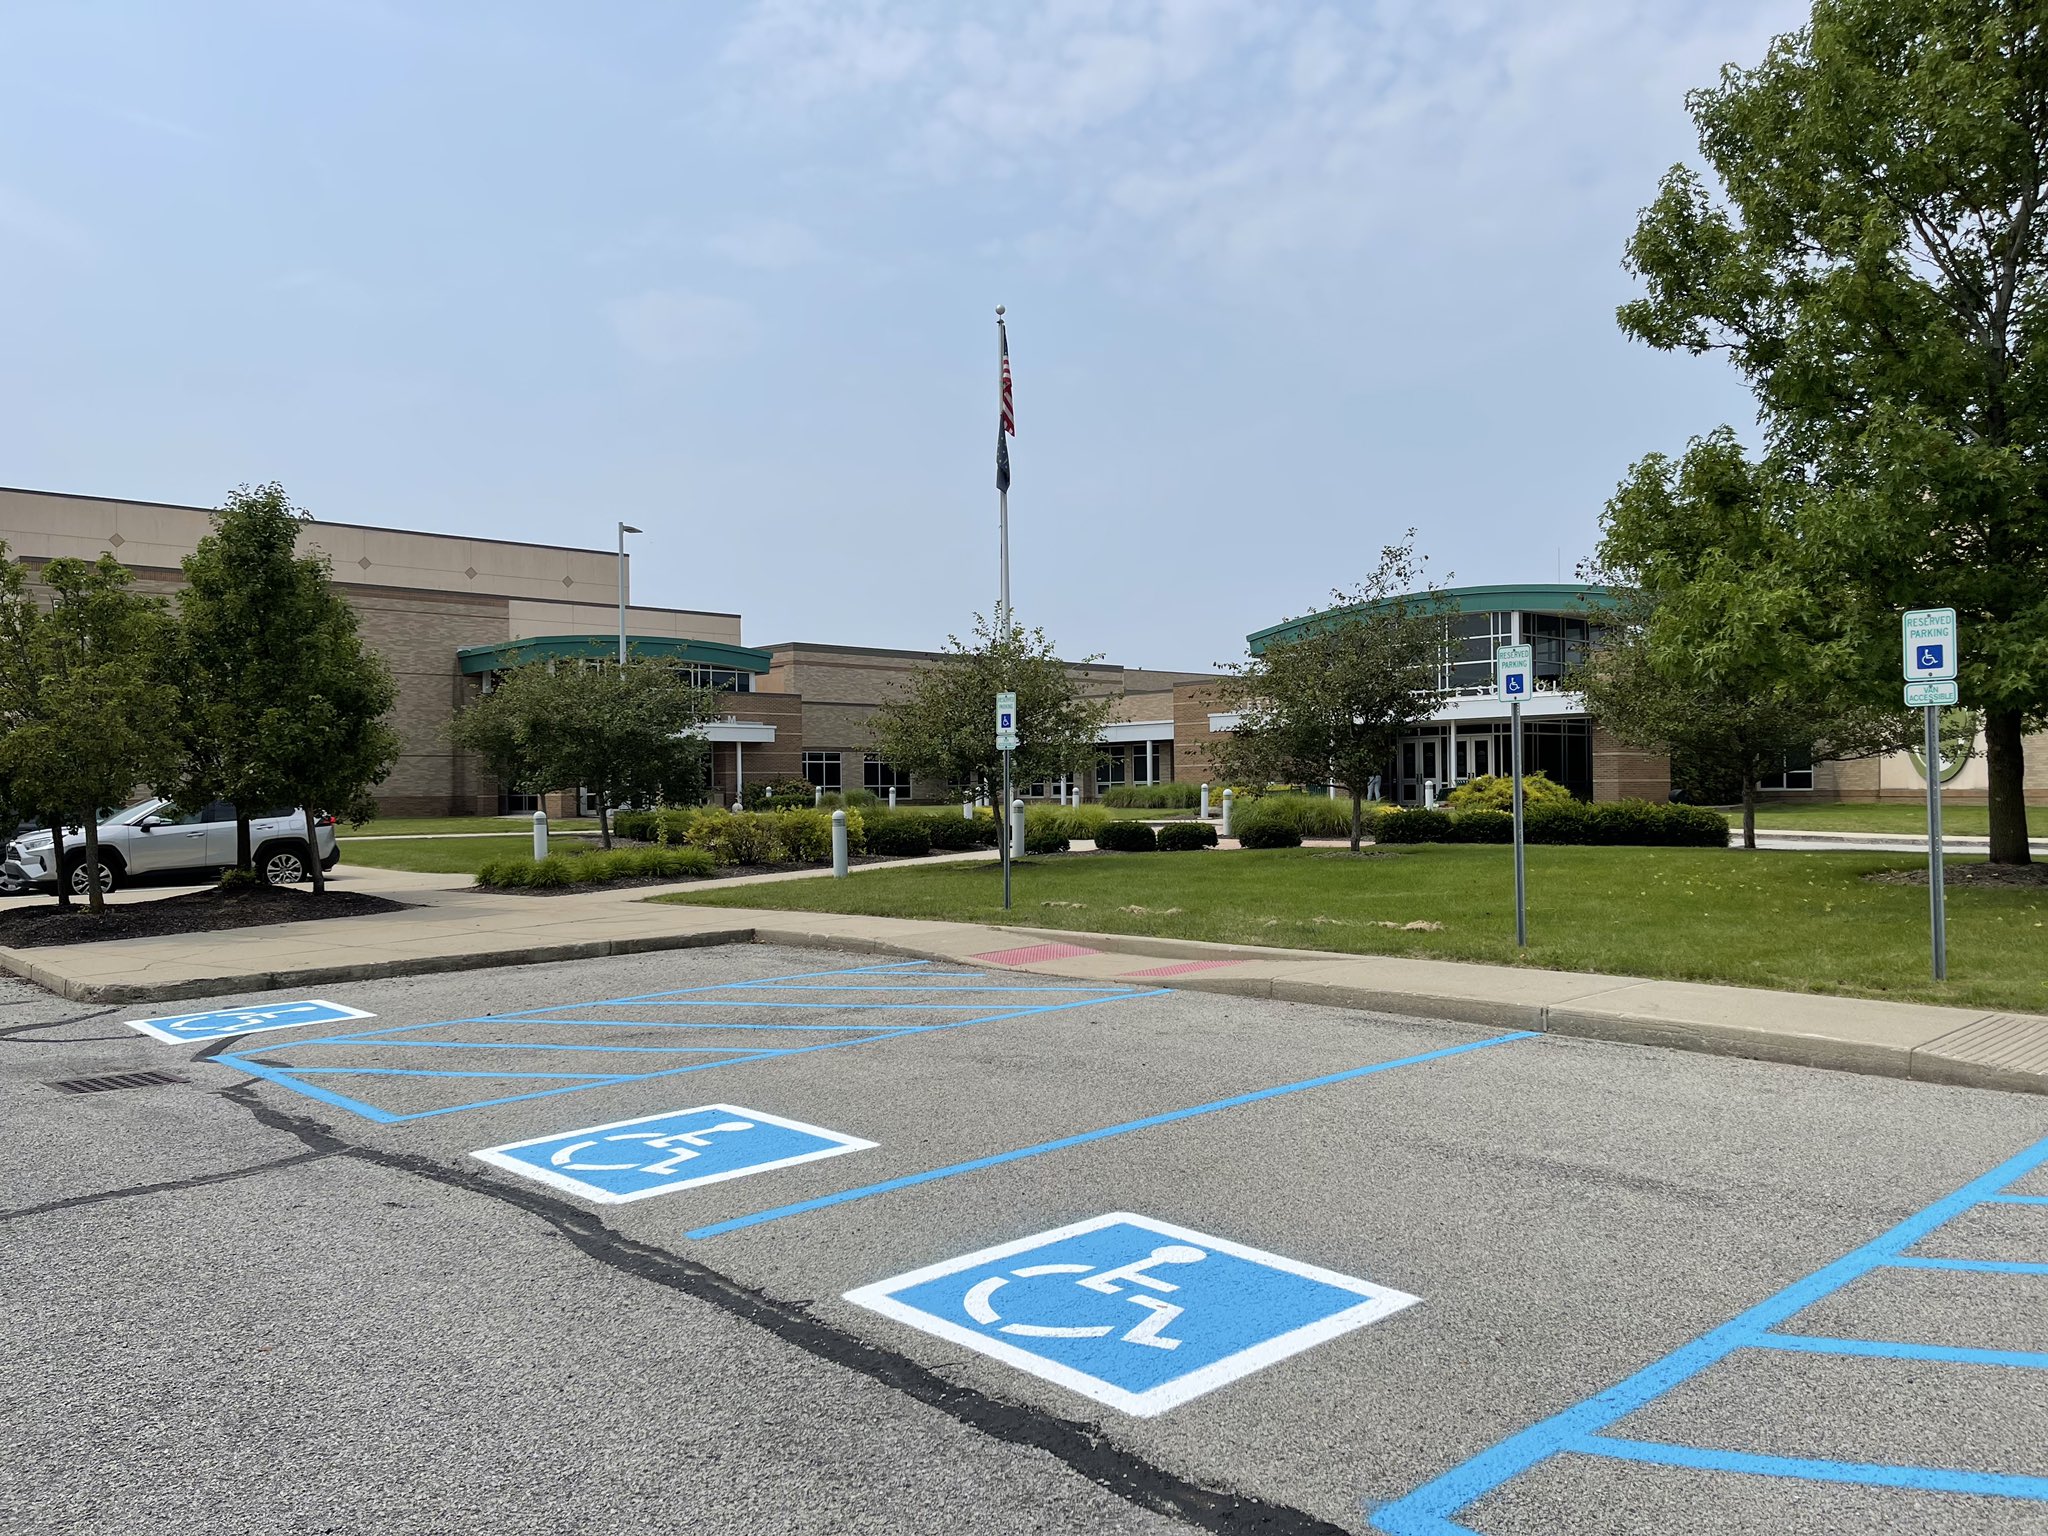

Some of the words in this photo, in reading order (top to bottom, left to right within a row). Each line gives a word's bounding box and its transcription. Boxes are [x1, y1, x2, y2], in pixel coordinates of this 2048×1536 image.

[1907, 616, 1951, 627] RESERVED
[1911, 628, 1949, 638] PARKING
[1500, 650, 1529, 660] RESERVED
[1502, 660, 1527, 669] PARKING
[1909, 693, 1953, 701] ACCESSIBLE
